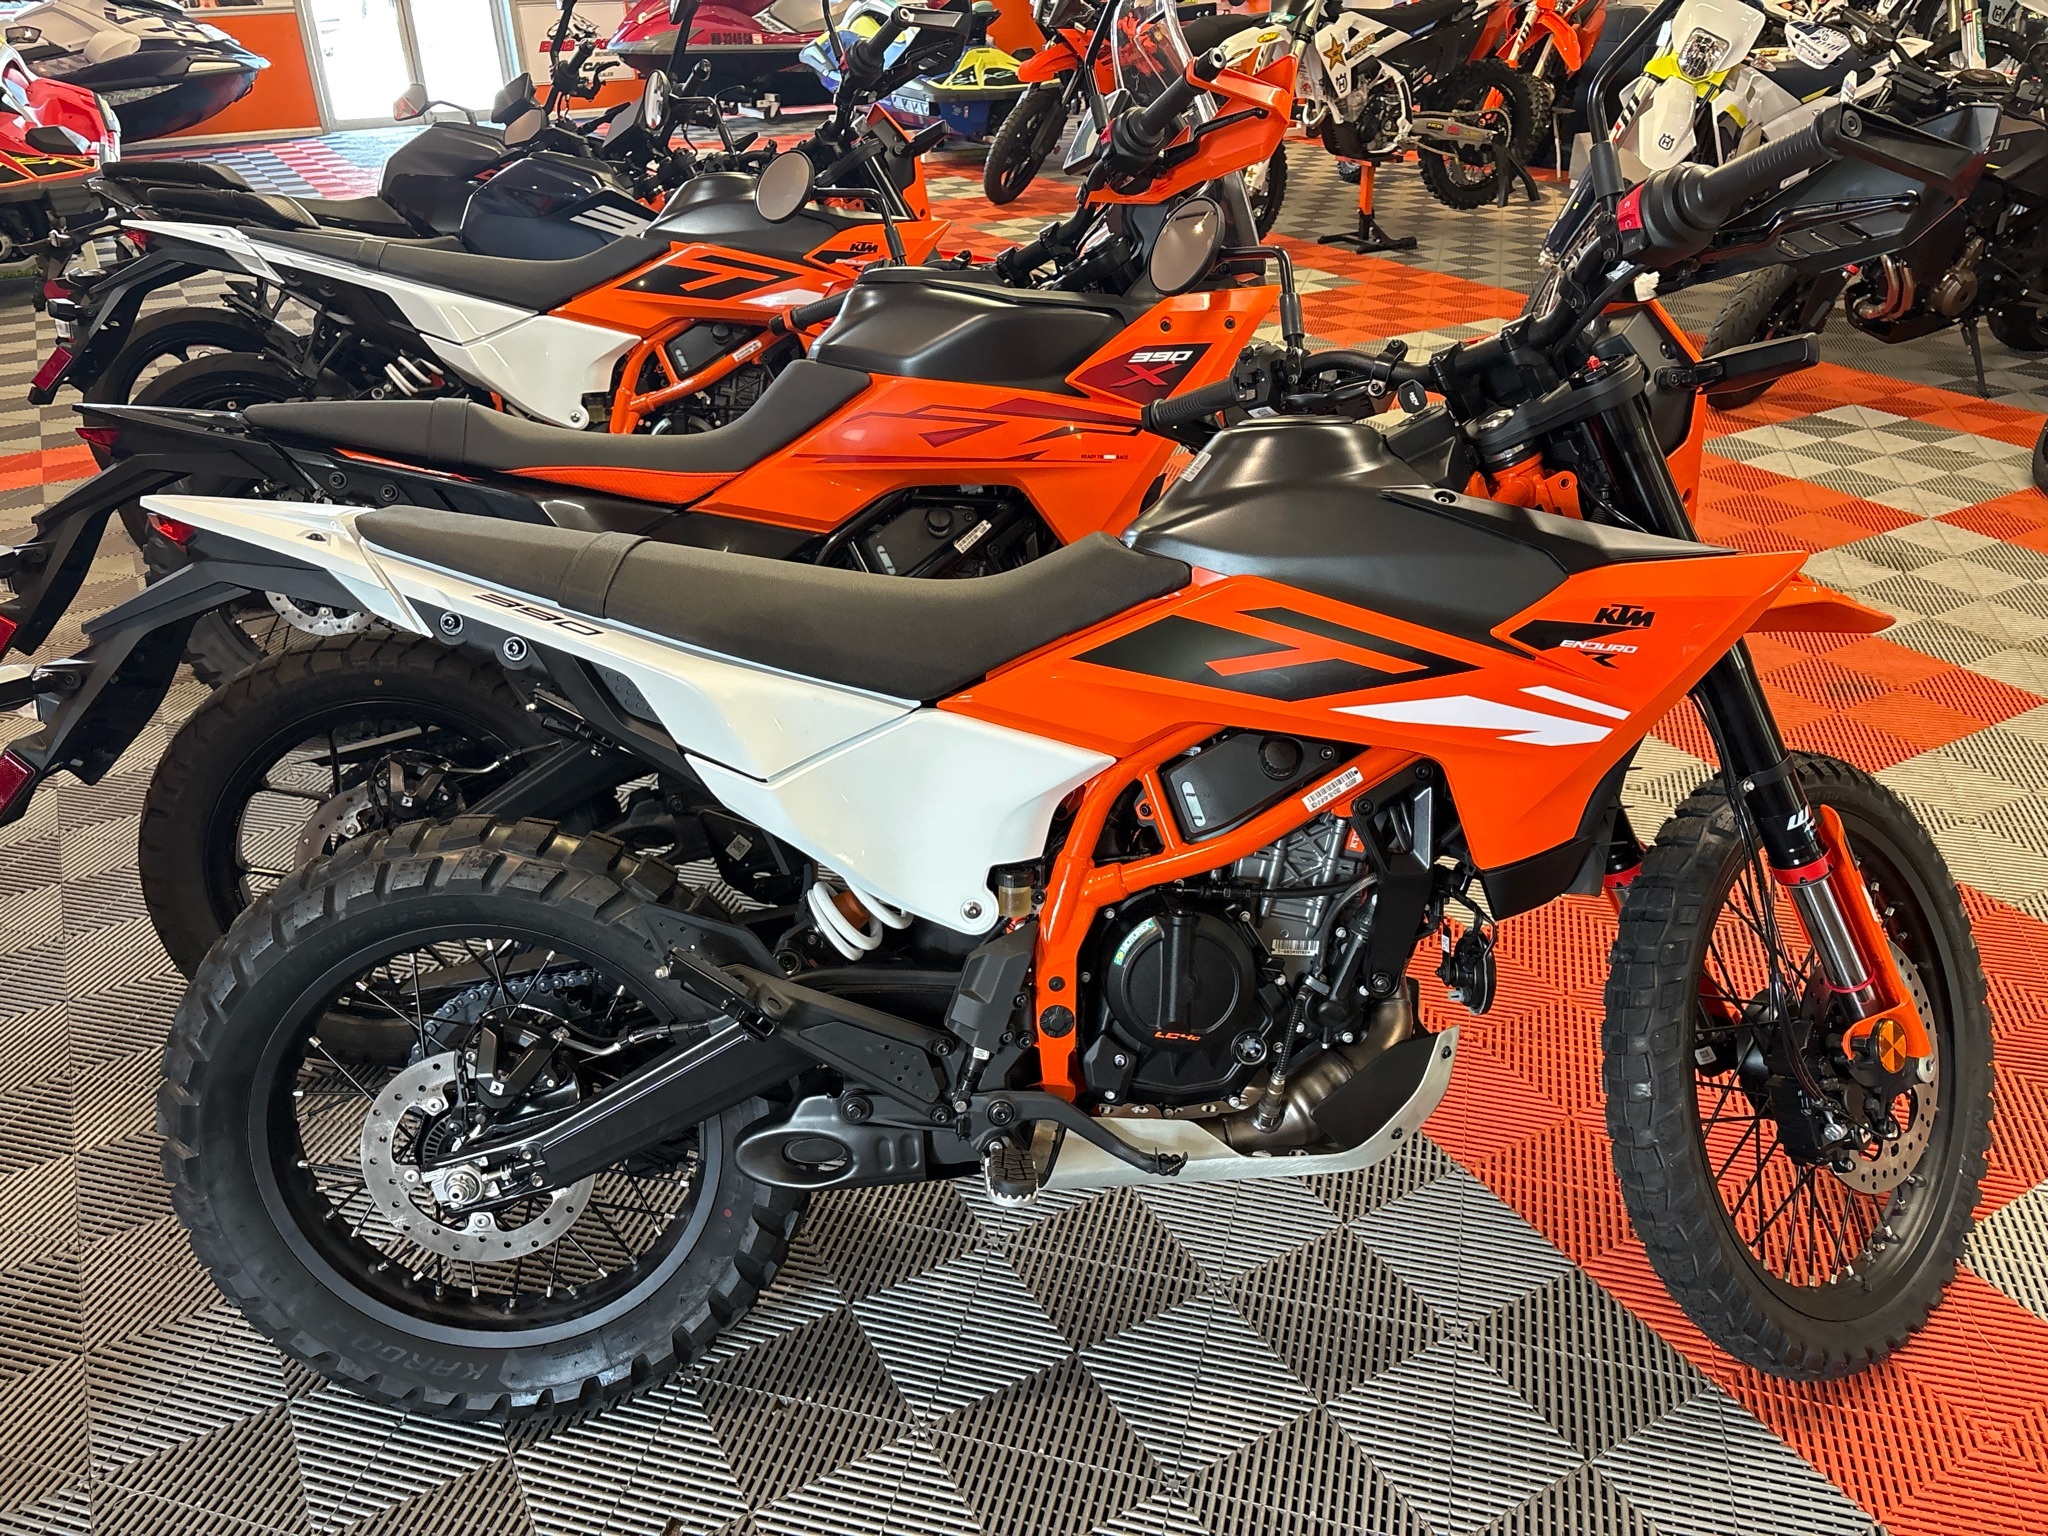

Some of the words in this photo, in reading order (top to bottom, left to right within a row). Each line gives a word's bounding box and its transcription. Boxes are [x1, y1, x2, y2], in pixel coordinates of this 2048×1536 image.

[849, 242, 878, 253] KTM
[1128, 351, 1193, 363] 390
[1110, 363, 1181, 388] X
[472, 593, 604, 635] 390
[1593, 603, 1655, 628] KTM
[1559, 640, 1638, 654] ENDURO
[1121, 918, 1154, 953] MOTOREX
